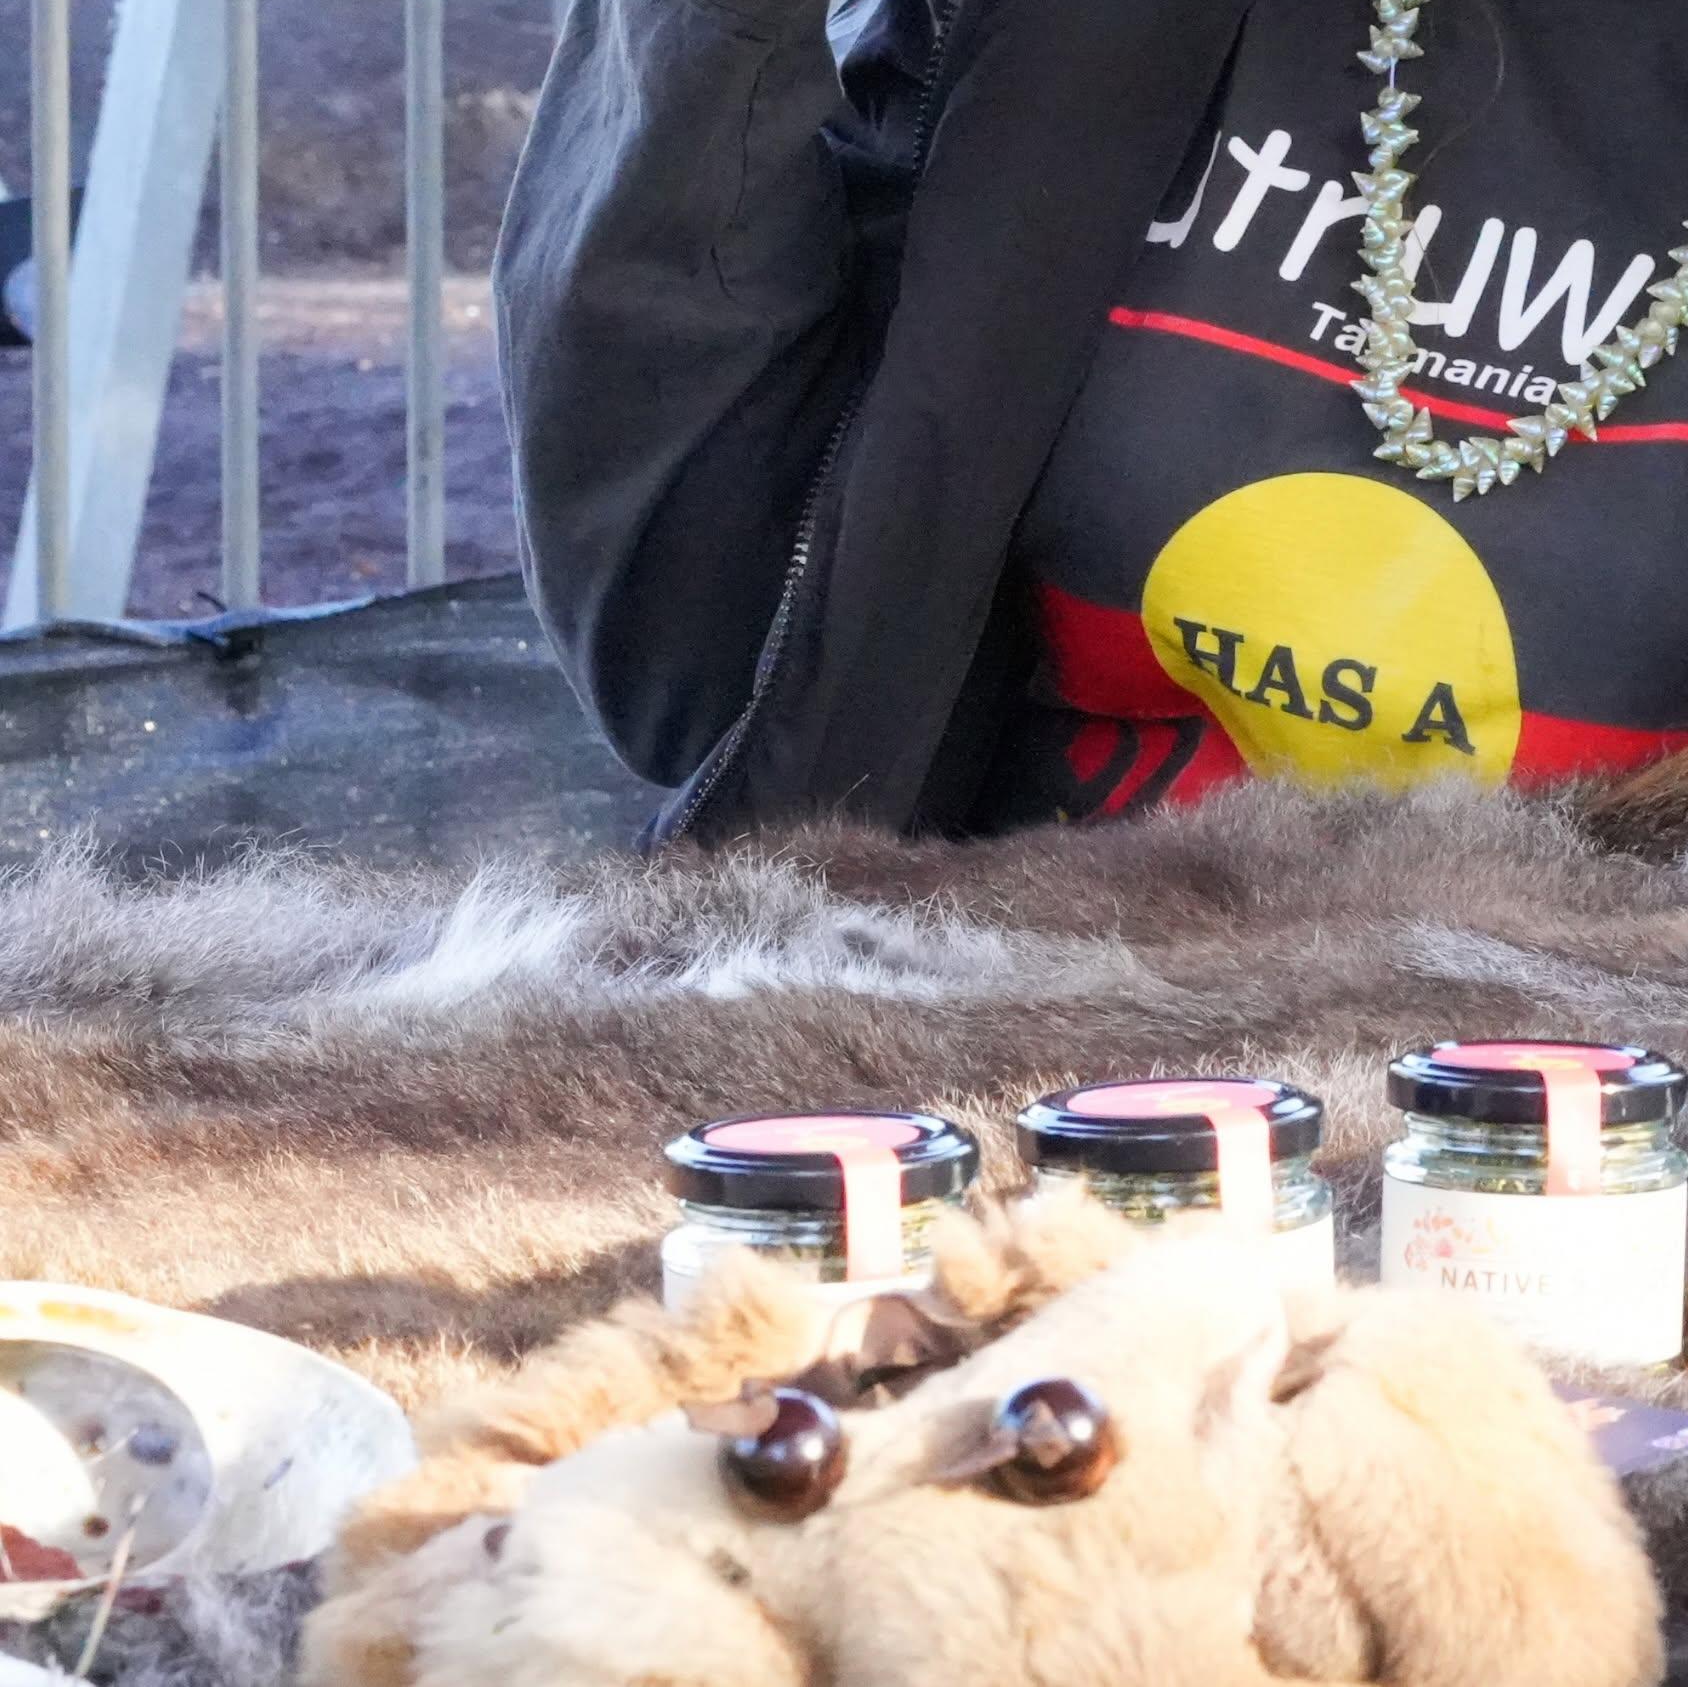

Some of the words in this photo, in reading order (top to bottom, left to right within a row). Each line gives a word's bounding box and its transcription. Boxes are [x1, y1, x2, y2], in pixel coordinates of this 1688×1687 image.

[1309, 301, 1558, 406] Tamania
[1173, 616, 1378, 731] HAS
[1401, 682, 1476, 755] A
[1440, 1266, 1553, 1297] NATIVE
